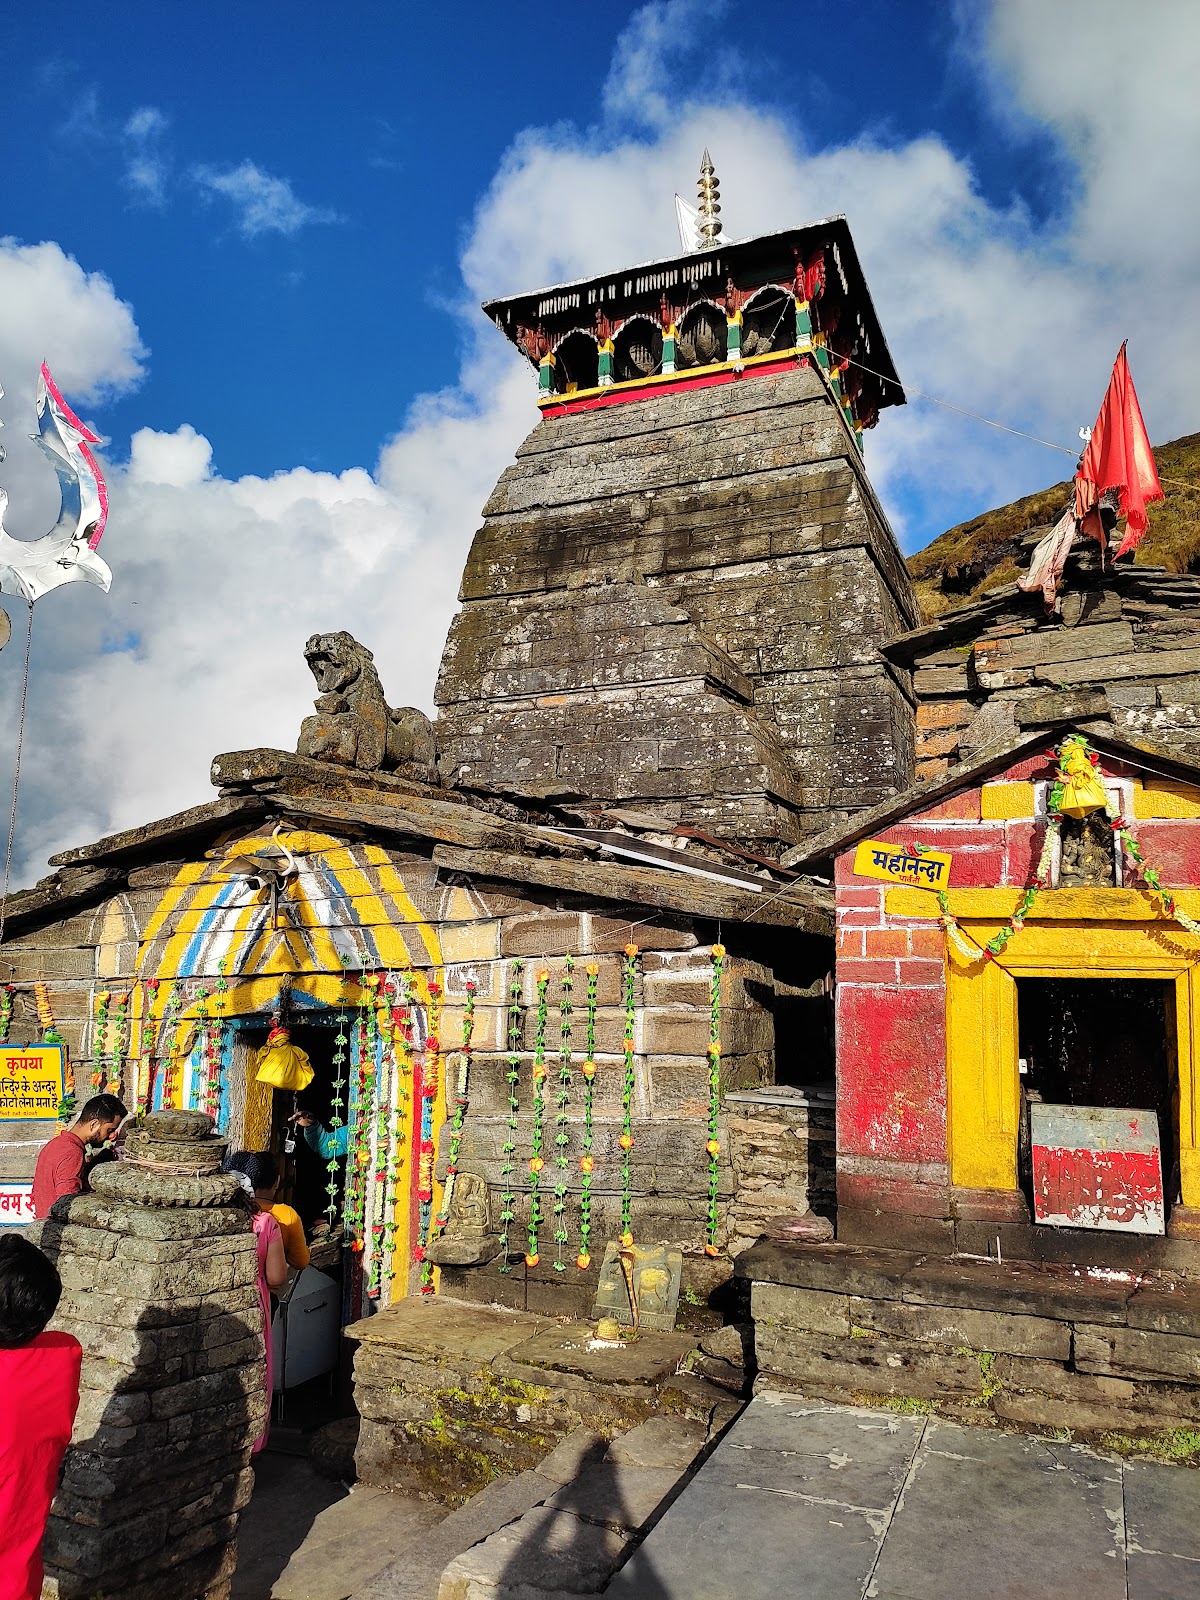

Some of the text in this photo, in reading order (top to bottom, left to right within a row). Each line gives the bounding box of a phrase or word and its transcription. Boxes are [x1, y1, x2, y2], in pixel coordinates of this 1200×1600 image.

[872, 849, 945, 883] महानन्दा
[6, 1057, 43, 1076] कृपया
[0, 1076, 56, 1094] न्दिर के अन्दर
[19, 1093, 34, 1108] लेना
[36, 1097, 50, 1108] मना
[0, 1191, 23, 1216] वम्
